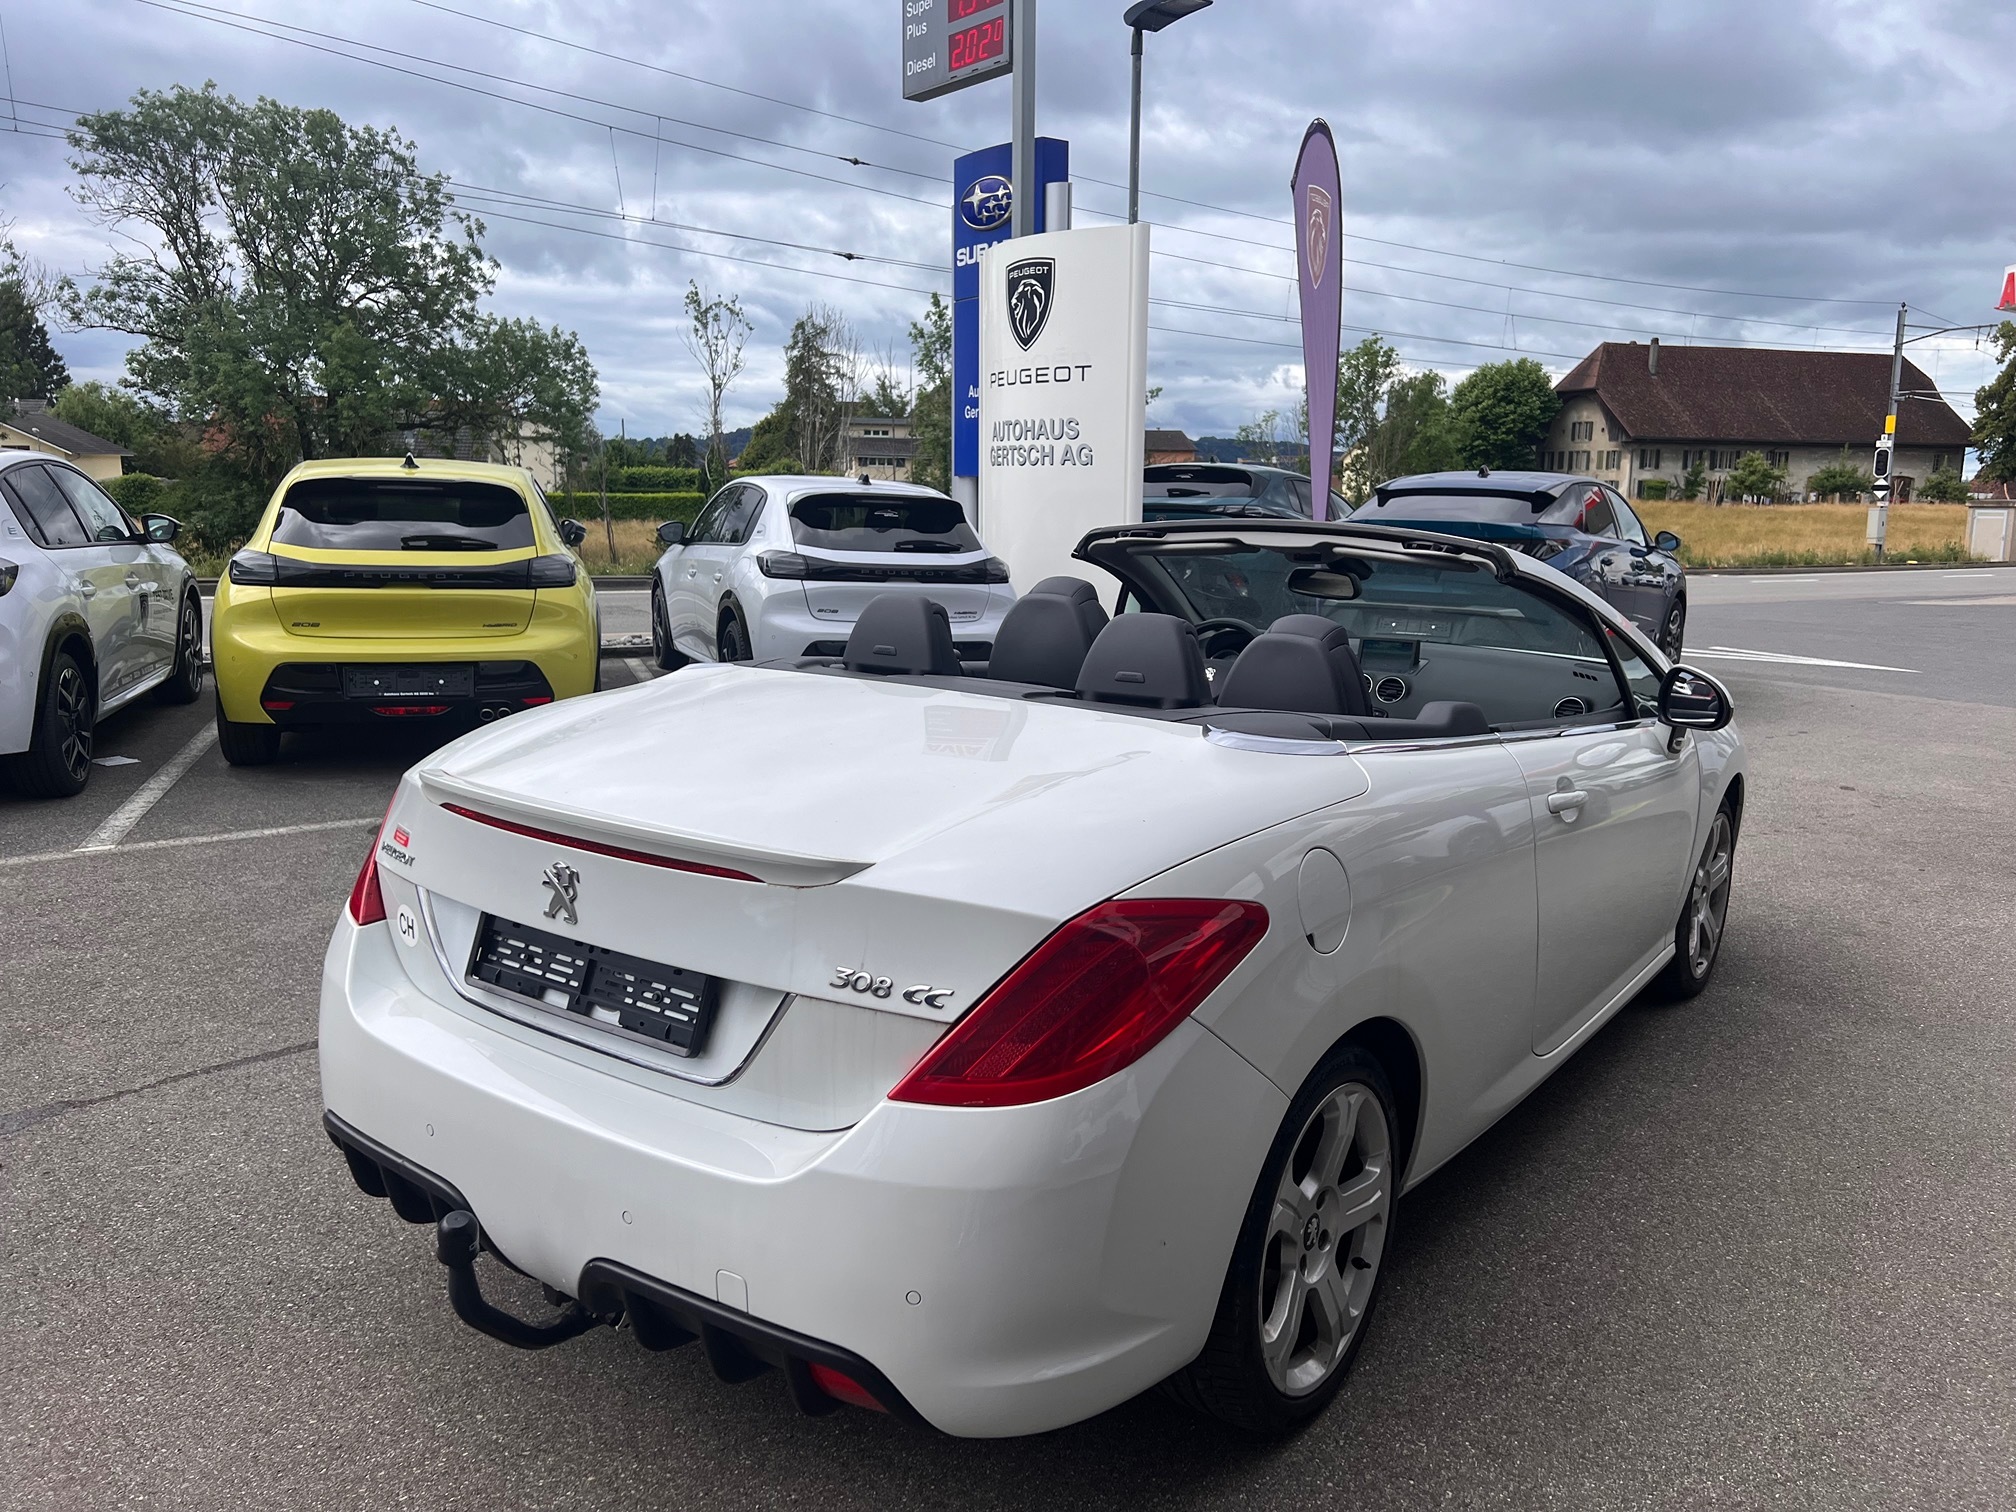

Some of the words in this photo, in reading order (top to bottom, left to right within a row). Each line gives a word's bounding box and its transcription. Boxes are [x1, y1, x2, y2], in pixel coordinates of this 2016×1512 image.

[906, 0, 933, 17] Super
[906, 22, 928, 40] Plus
[906, 52, 936, 76] Diesel
[1009, 266, 1050, 280] PEUGEOT
[990, 365, 1093, 388] PEUGEOT
[968, 385, 979, 398] Au
[964, 405, 979, 419] Ger
[992, 417, 1080, 442] AUTOHAUS
[990, 444, 1054, 467] GERTSCH
[1060, 443, 1093, 466] AG
[344, 571, 463, 580] PEUGEOT
[399, 912, 415, 939] CH
[829, 966, 893, 999] 308
[902, 983, 955, 1010] CC
